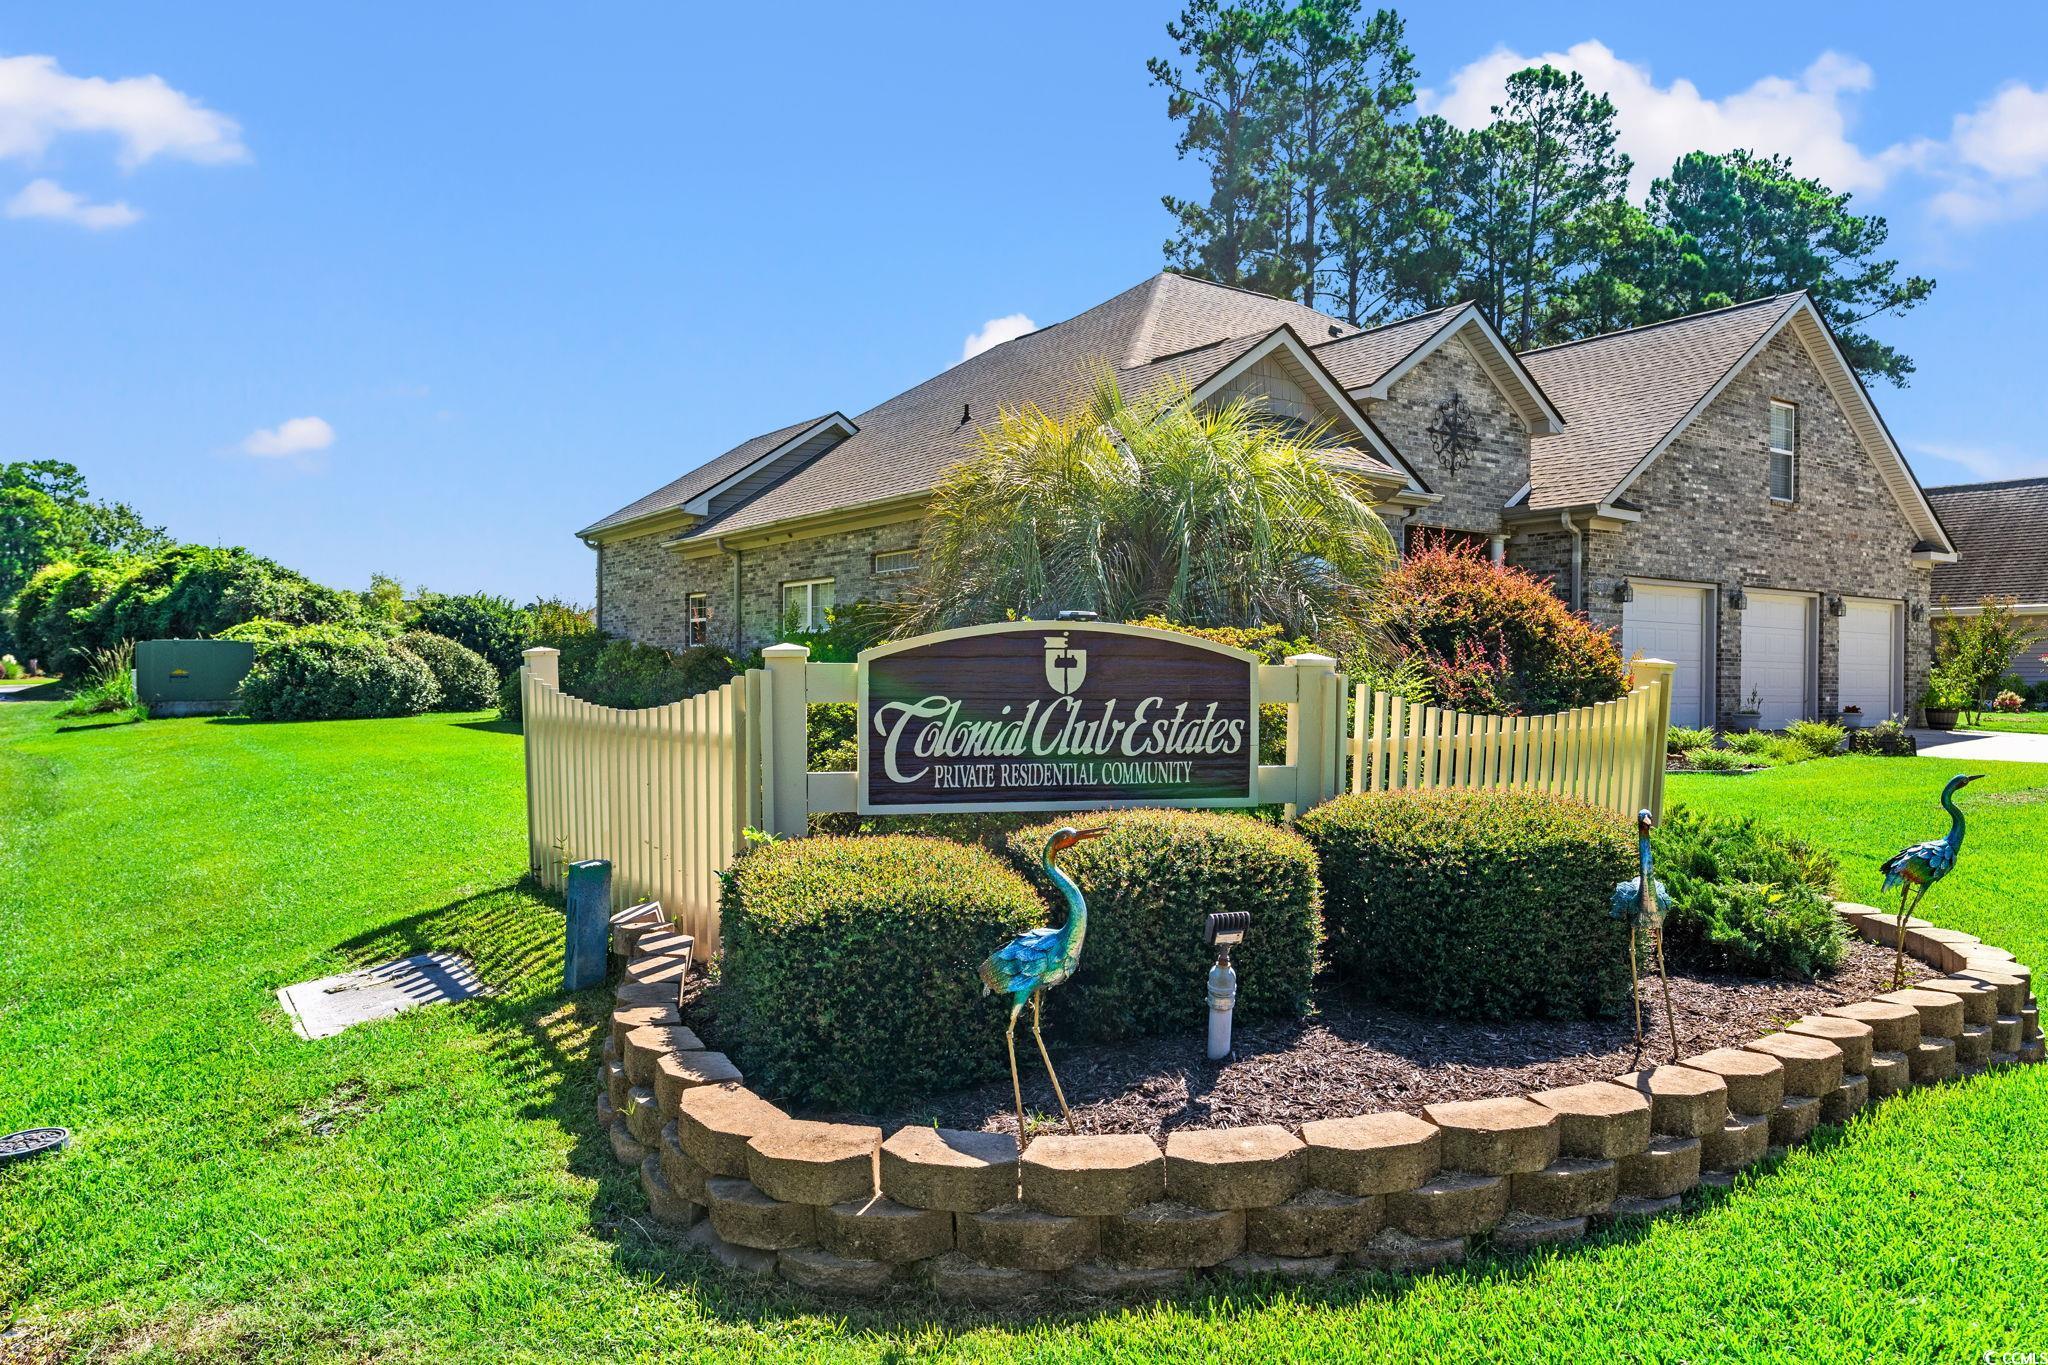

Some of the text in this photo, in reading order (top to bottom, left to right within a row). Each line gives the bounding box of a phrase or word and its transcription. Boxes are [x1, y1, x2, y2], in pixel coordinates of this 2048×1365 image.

[873, 695, 1245, 783] Colonial Club Estates
[933, 760, 1193, 789] PRIVATE RESIDENTIAL COMMUNITY
